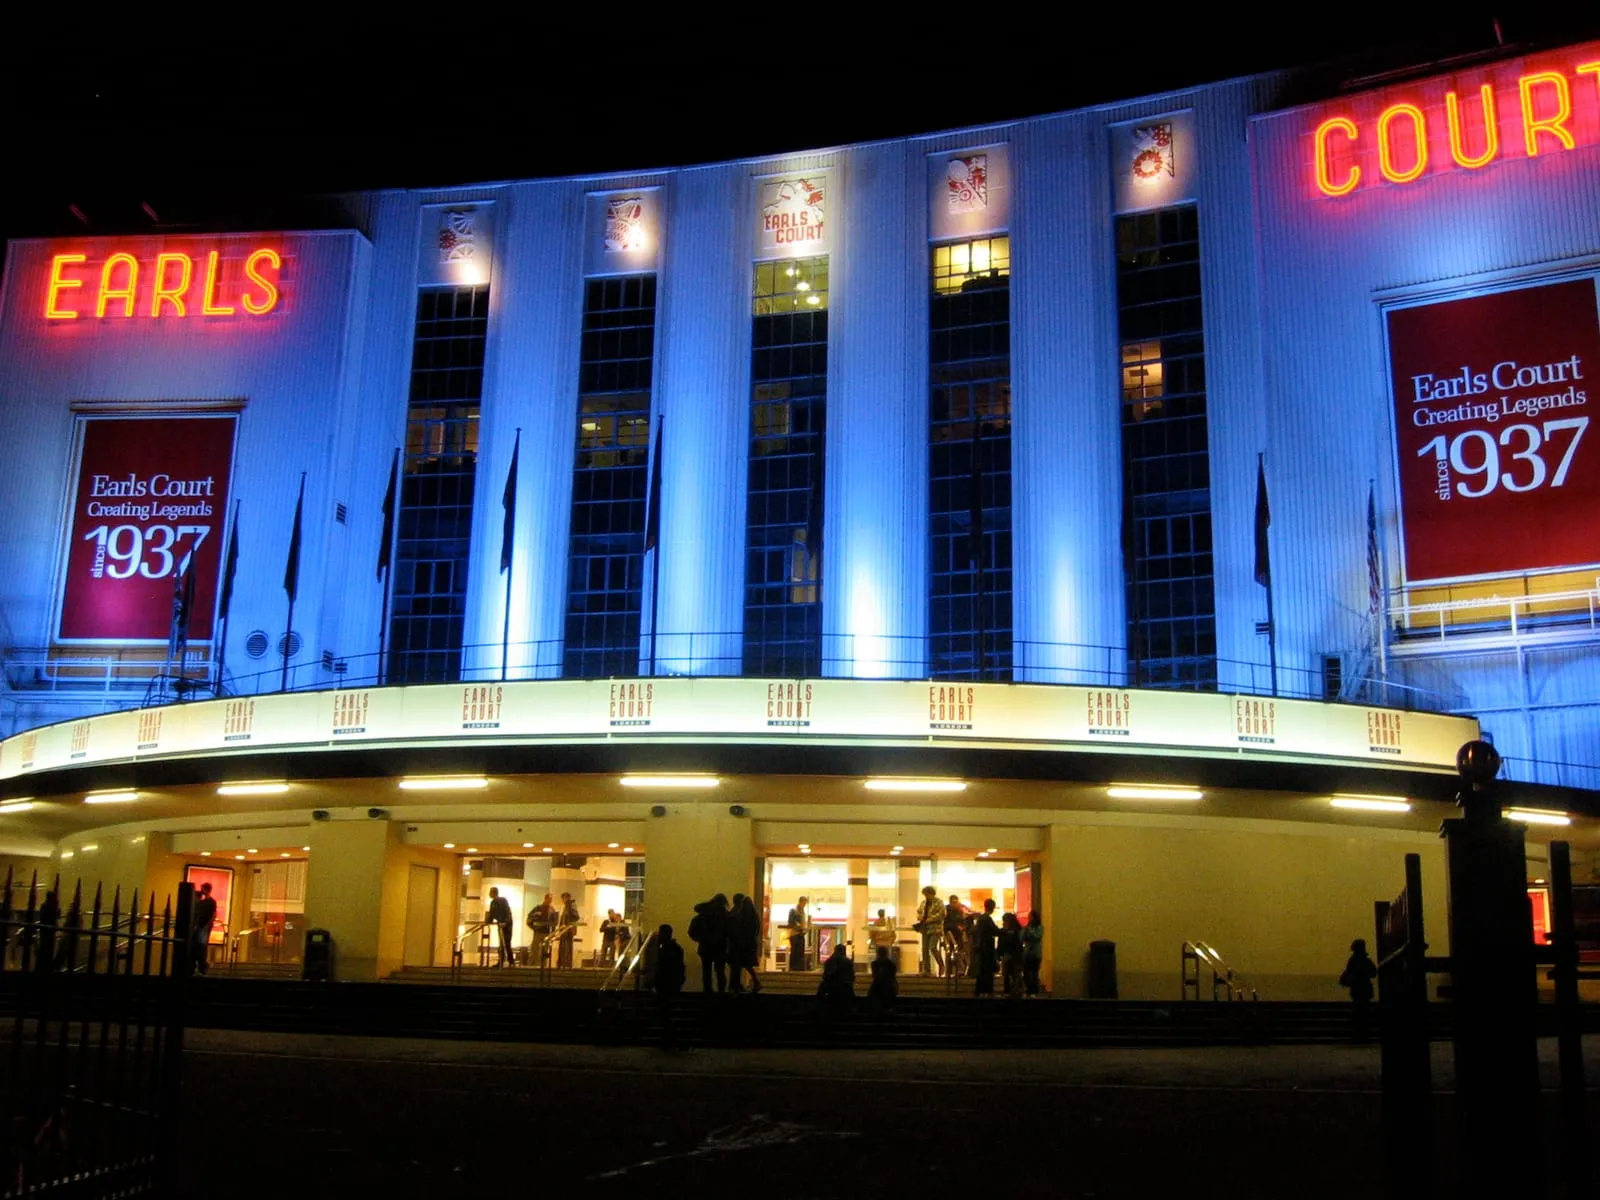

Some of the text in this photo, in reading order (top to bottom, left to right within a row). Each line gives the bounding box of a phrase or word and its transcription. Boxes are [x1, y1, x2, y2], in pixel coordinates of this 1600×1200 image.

[764, 211, 808, 230] EARLS
[776, 223, 824, 244] COURT
[45, 248, 281, 319] EARLS
[1411, 354, 1584, 403] Earls Court
[1413, 386, 1586, 427] Creating Legends
[1417, 416, 1590, 498] 1937
[90, 473, 214, 497] Earls Court
[1435, 460, 1450, 501] since
[87, 501, 212, 521] Creating Legends
[84, 524, 211, 579] 1937
[463, 687, 504, 704] EARLS
[610, 684, 653, 700] EARLS
[767, 684, 812, 700] EARLS
[929, 687, 974, 704] EARLS
[1088, 692, 1130, 710] EARLS
[225, 700, 255, 717] EARLS
[334, 693, 369, 711] EARLS
[610, 701, 652, 717] COURT
[767, 701, 811, 718] COURT
[1236, 700, 1275, 718] EARLS
[333, 709, 367, 727] COURT
[462, 703, 501, 721] COURT
[929, 704, 973, 721] COURT
[1088, 710, 1129, 727] COURT
[1367, 711, 1401, 730] EARLS
[1236, 717, 1275, 735] COURT
[1368, 728, 1401, 746] COURT
